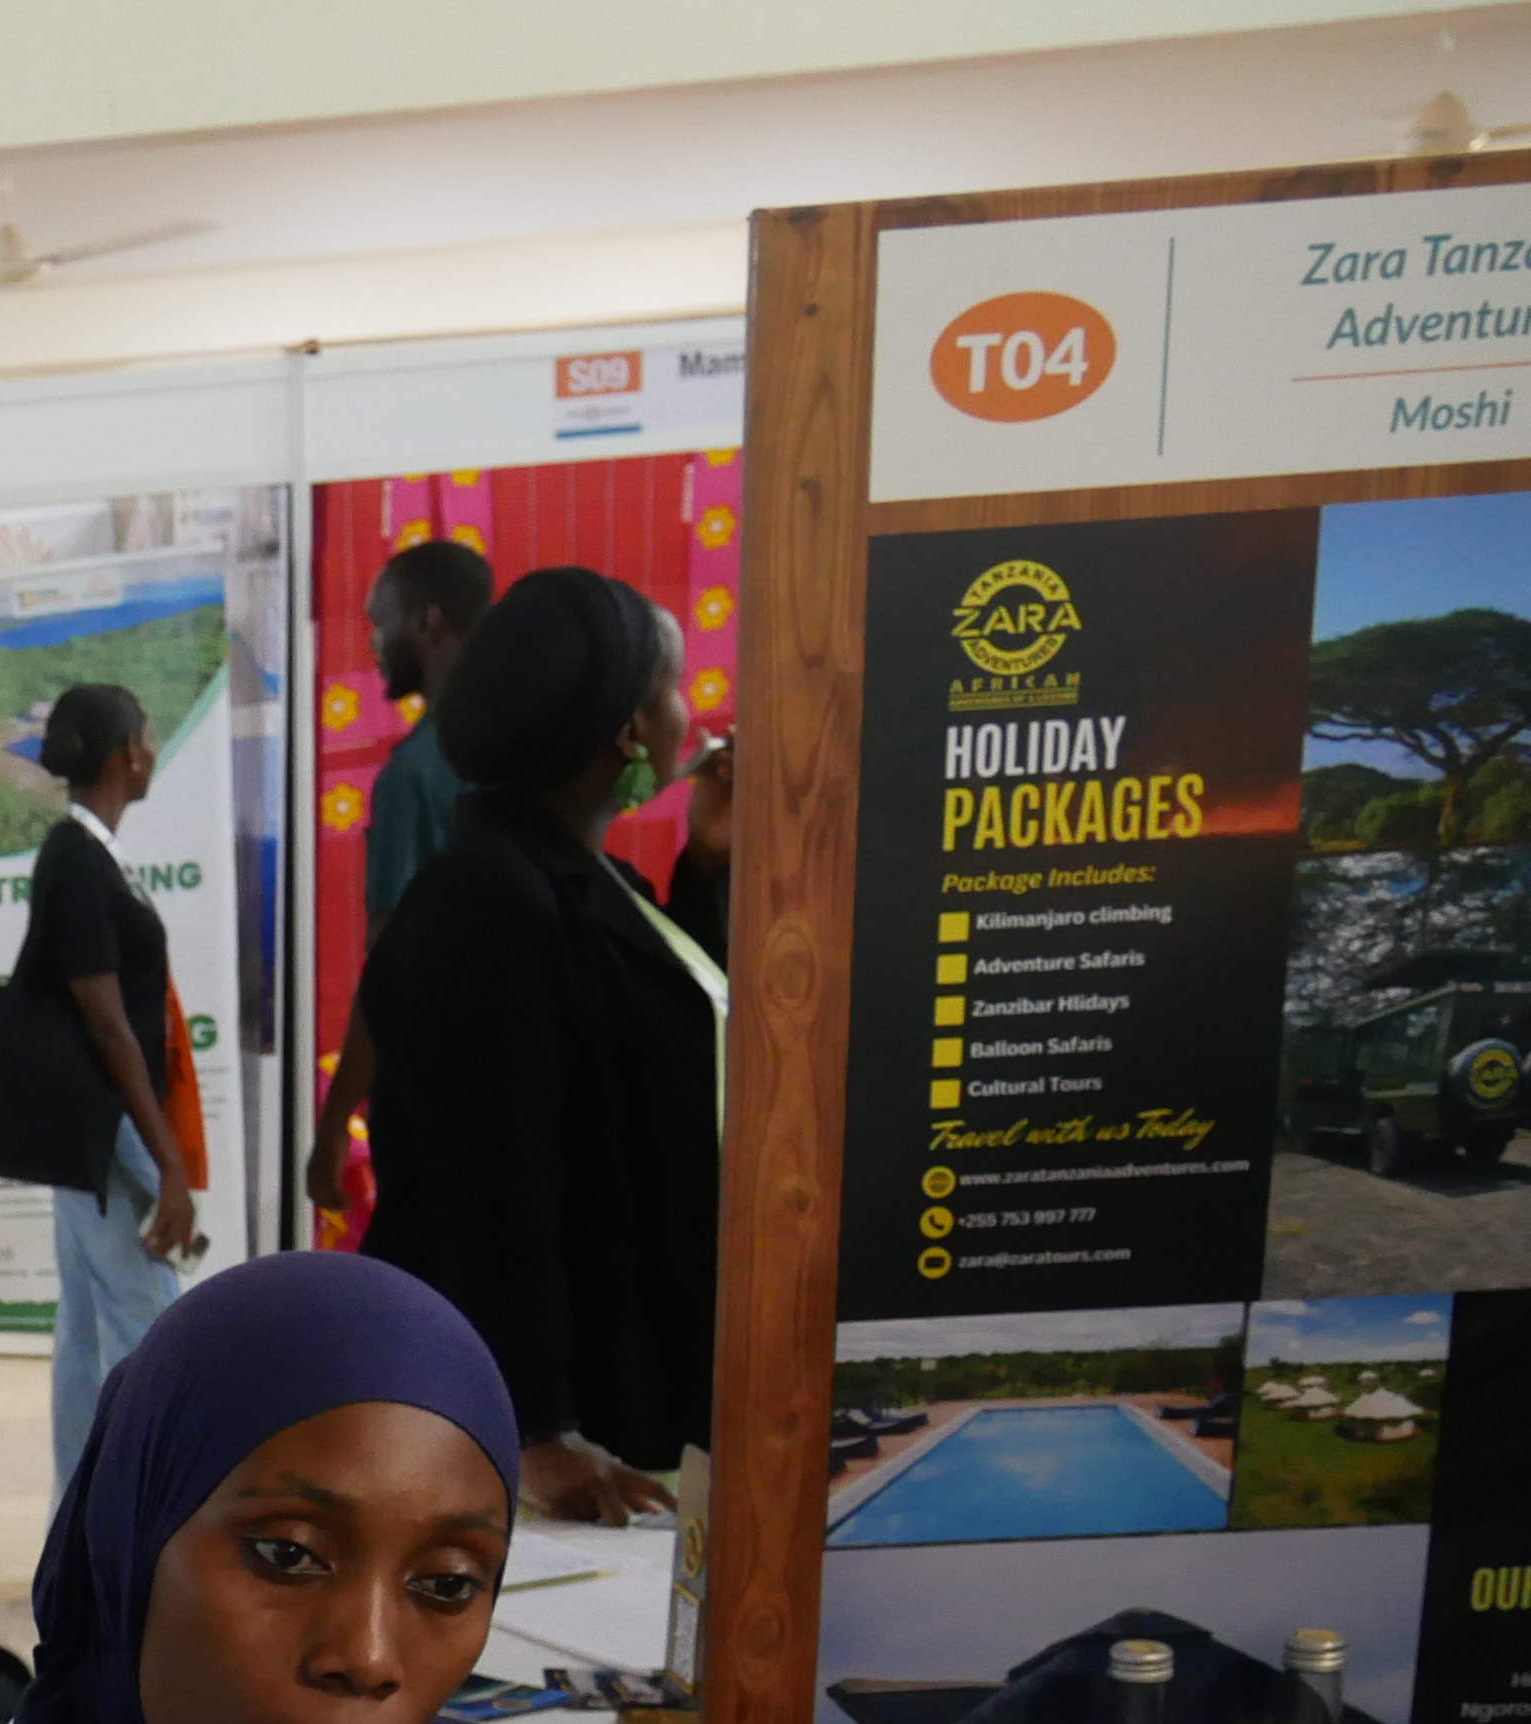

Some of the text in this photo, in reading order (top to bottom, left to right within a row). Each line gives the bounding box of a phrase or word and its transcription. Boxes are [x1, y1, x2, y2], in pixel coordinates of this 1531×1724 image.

[1301, 242, 1407, 286] Zara
[569, 356, 630, 392] S09
[955, 327, 1091, 393] T04
[1390, 388, 1514, 433] Moshi
[970, 564, 1059, 599] TANZANIA
[951, 602, 1083, 637] ZARA
[945, 715, 1127, 780] HOLIDAY
[942, 772, 1205, 852] PACKAGES
[942, 862, 1156, 895] Package Includes:
[975, 902, 1173, 932] Kilimanjaro climbing
[973, 949, 1146, 976] Adventure Safaris
[971, 996, 1055, 1019] Zanzibar
[970, 1034, 1113, 1060] Balloon Safaris
[968, 1074, 1103, 1099] Cultural Tours
[928, 1107, 1216, 1151] Travel with us Today
[1069, 1206, 1098, 1224] 777
[958, 1247, 1132, 1270] zara@zaratours.com
